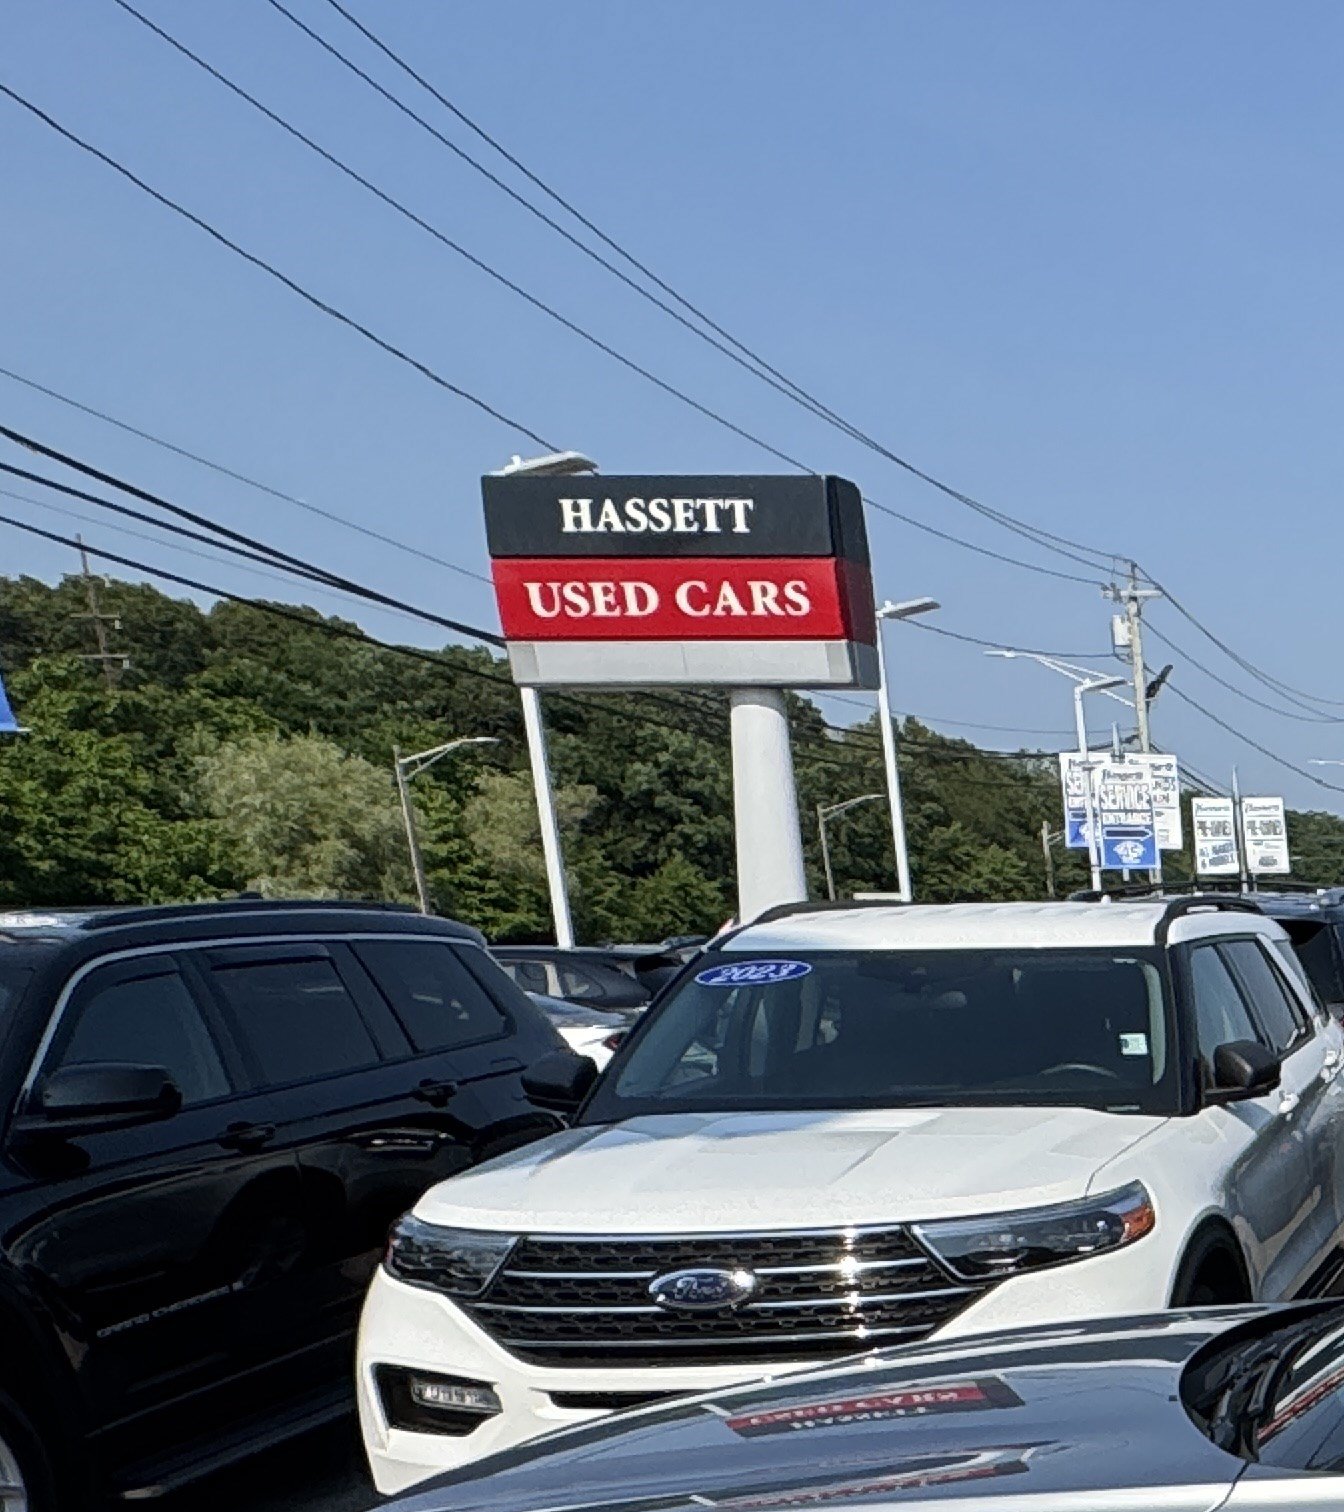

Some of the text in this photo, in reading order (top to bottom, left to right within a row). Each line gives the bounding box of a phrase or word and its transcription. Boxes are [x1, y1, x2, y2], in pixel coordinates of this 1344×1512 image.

[558, 497, 754, 534] HASSETT
[523, 579, 811, 618] USED CARS
